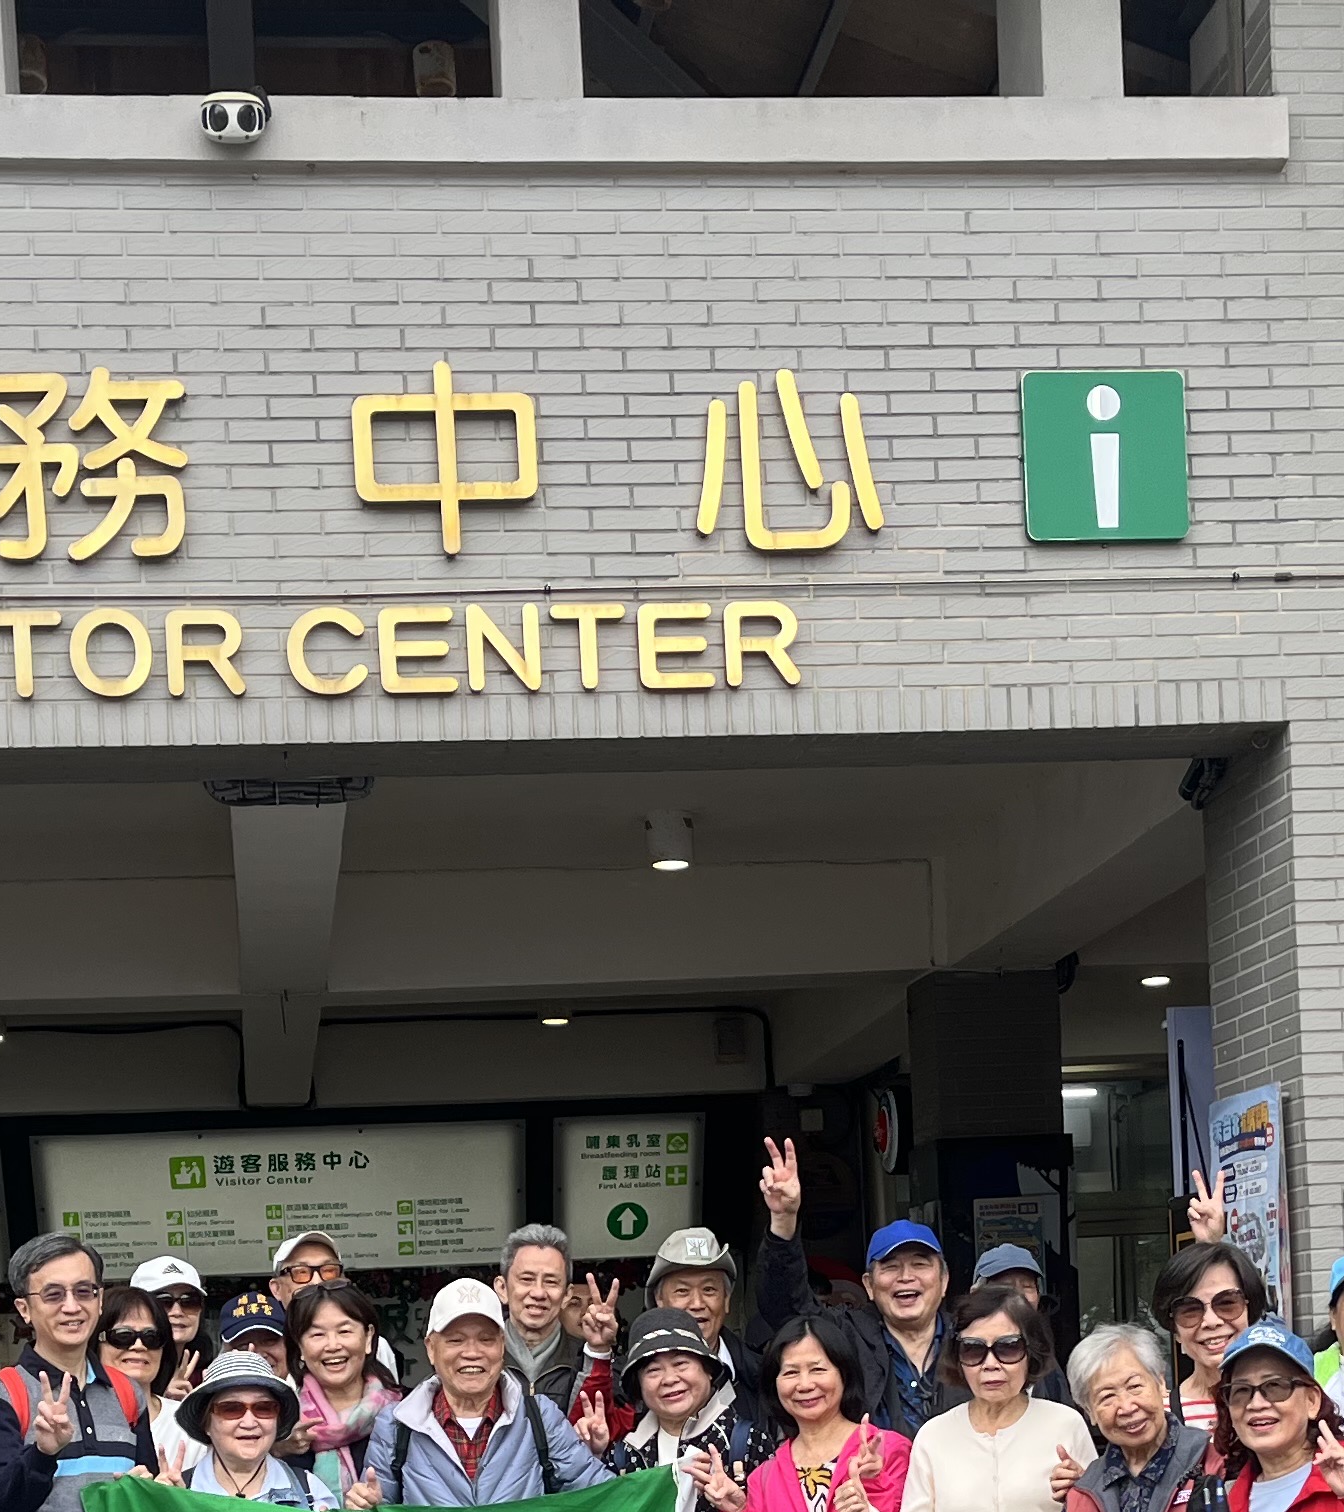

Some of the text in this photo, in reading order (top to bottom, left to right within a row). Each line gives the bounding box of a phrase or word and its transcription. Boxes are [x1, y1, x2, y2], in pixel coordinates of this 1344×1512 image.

[286, 599, 803, 695] CENTER
[586, 1134, 661, 1149] 哺集乳室
[213, 1150, 370, 1175] 遊客服務中心
[581, 1151, 638, 1159] Breastfeeding
[602, 1164, 661, 1180] 護理站
[215, 1175, 314, 1187] Visitor Center
